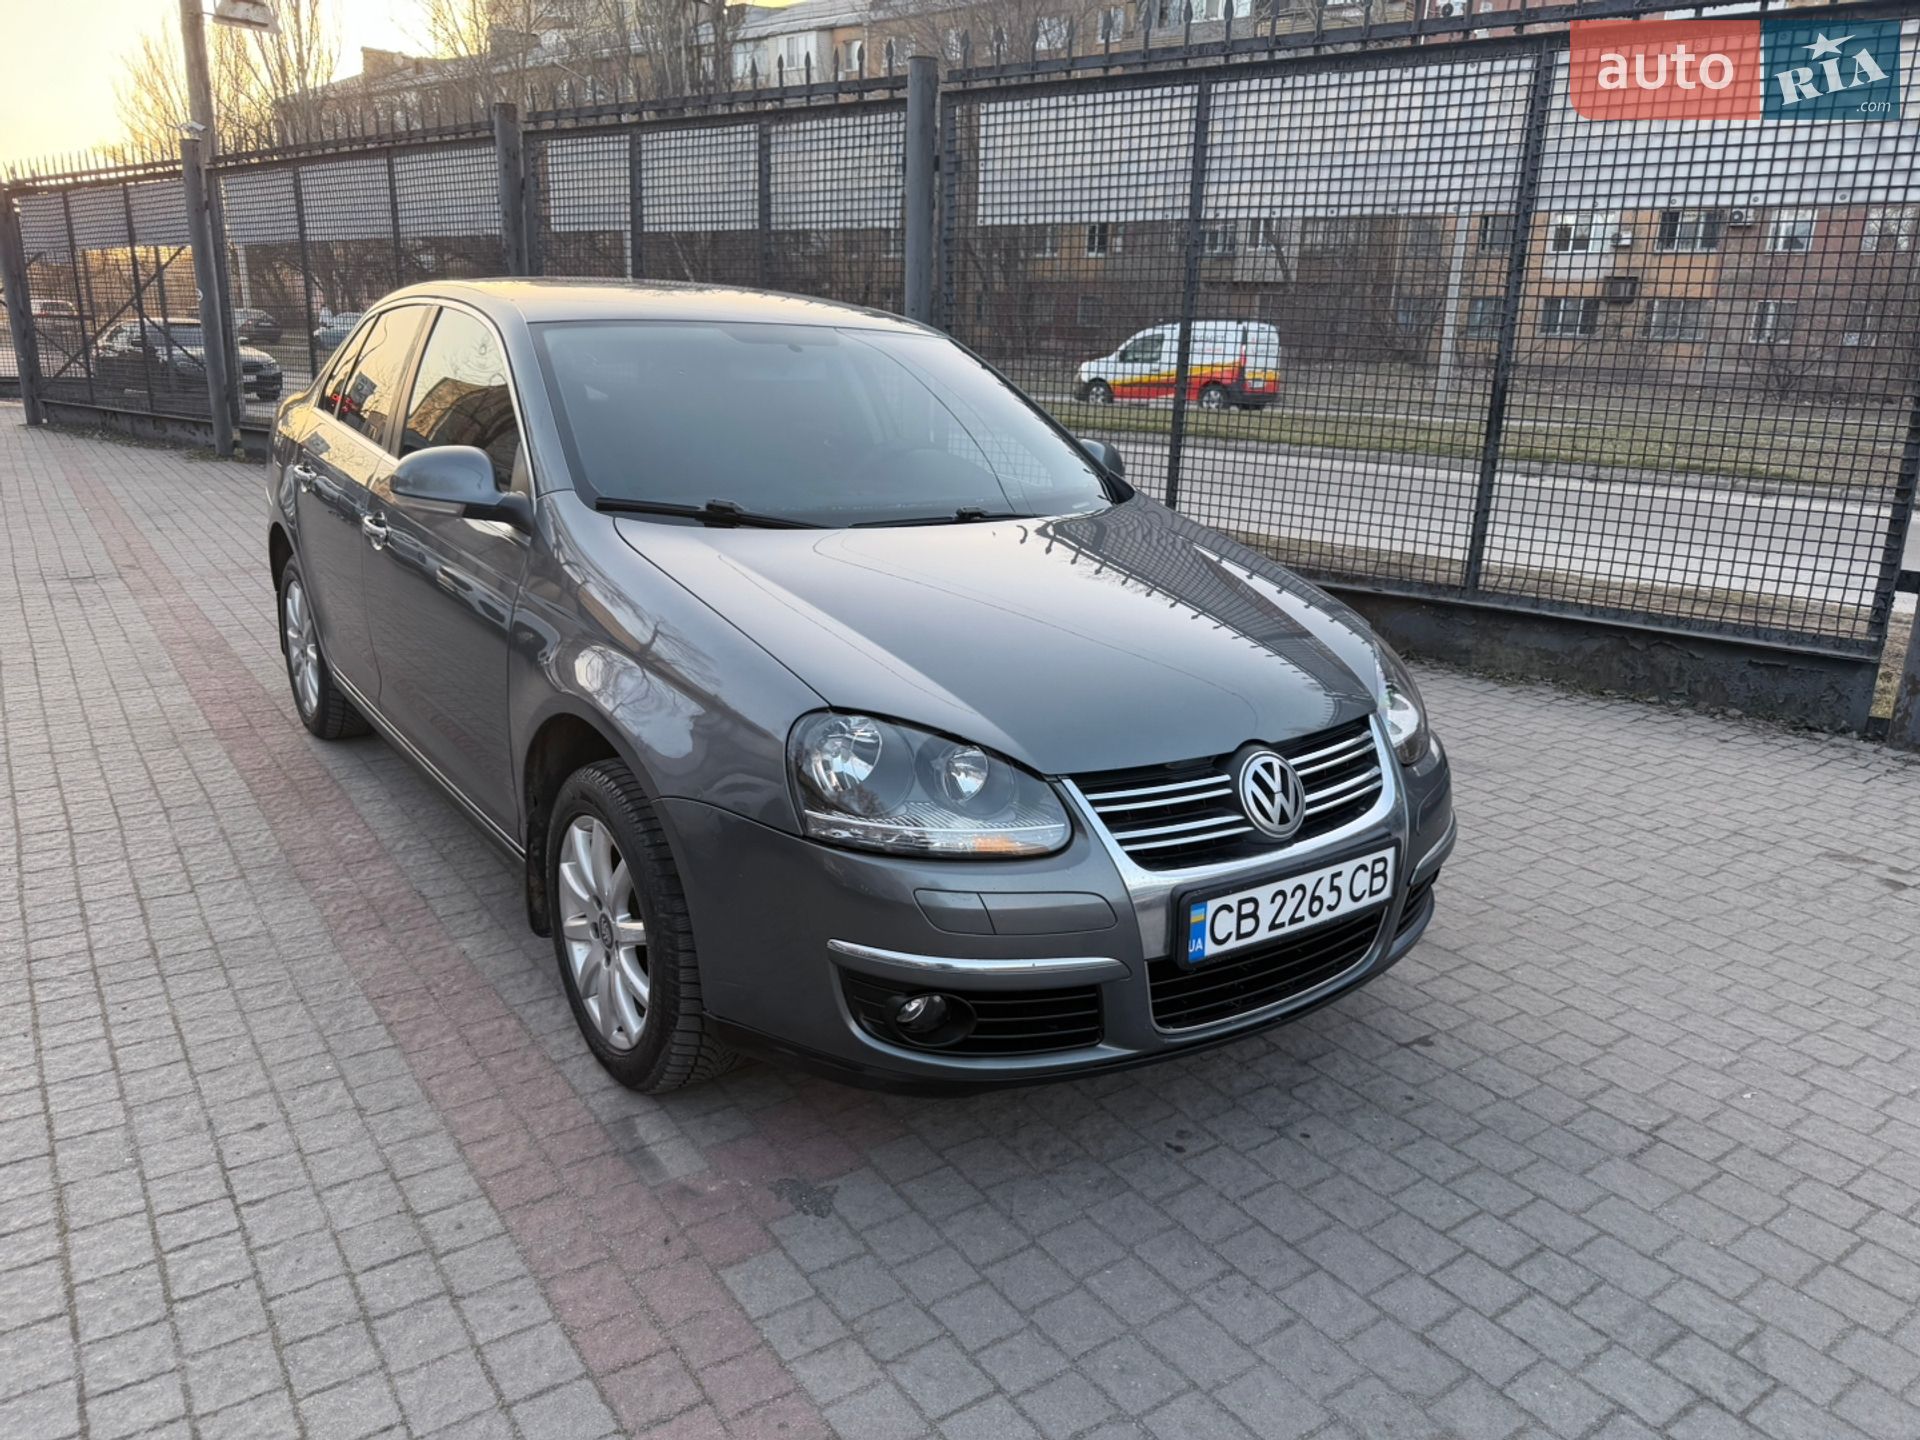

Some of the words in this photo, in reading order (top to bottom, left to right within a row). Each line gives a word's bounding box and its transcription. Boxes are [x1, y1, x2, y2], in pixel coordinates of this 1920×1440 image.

[1246, 756, 1303, 832] VW
[1209, 896, 1260, 946] CB
[1267, 870, 1343, 933] 2265
[1349, 855, 1388, 903] CB
[1188, 938, 1203, 952] UA
